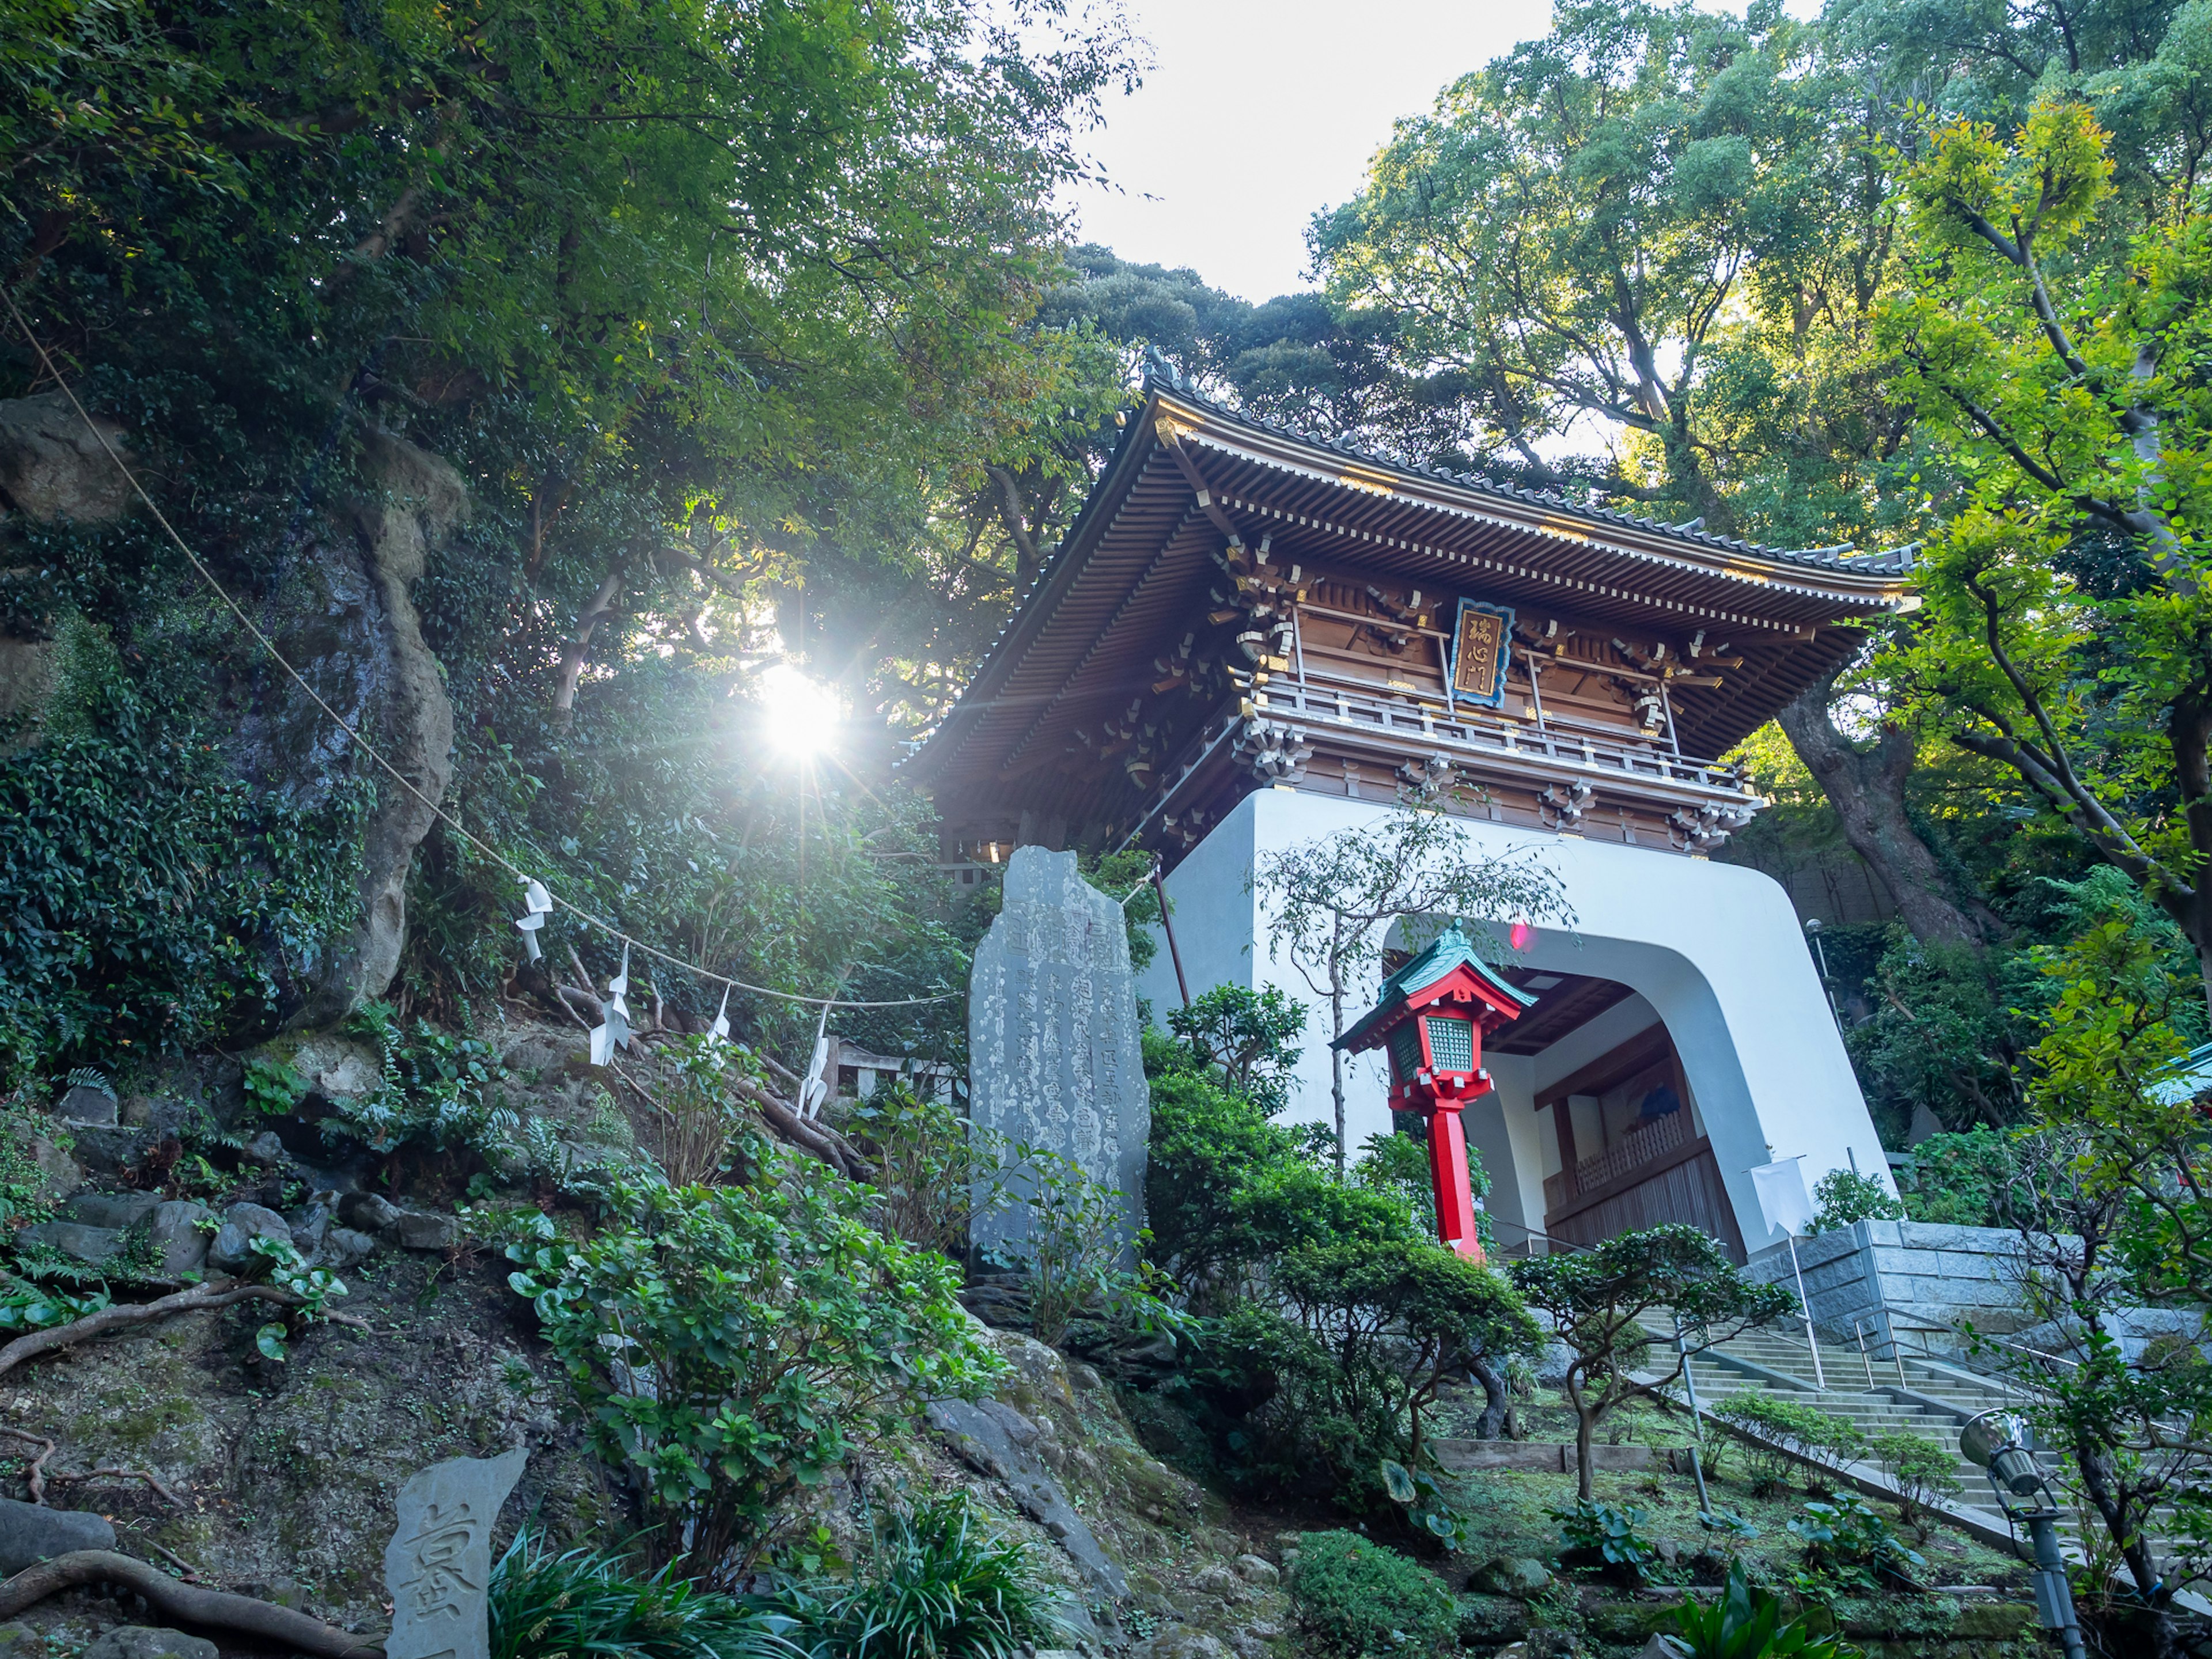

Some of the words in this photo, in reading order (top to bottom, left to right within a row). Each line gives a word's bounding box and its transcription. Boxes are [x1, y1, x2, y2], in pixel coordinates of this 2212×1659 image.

[1464, 618, 1493, 691] 瑞心門
[399, 1502, 482, 1659] 蟇
